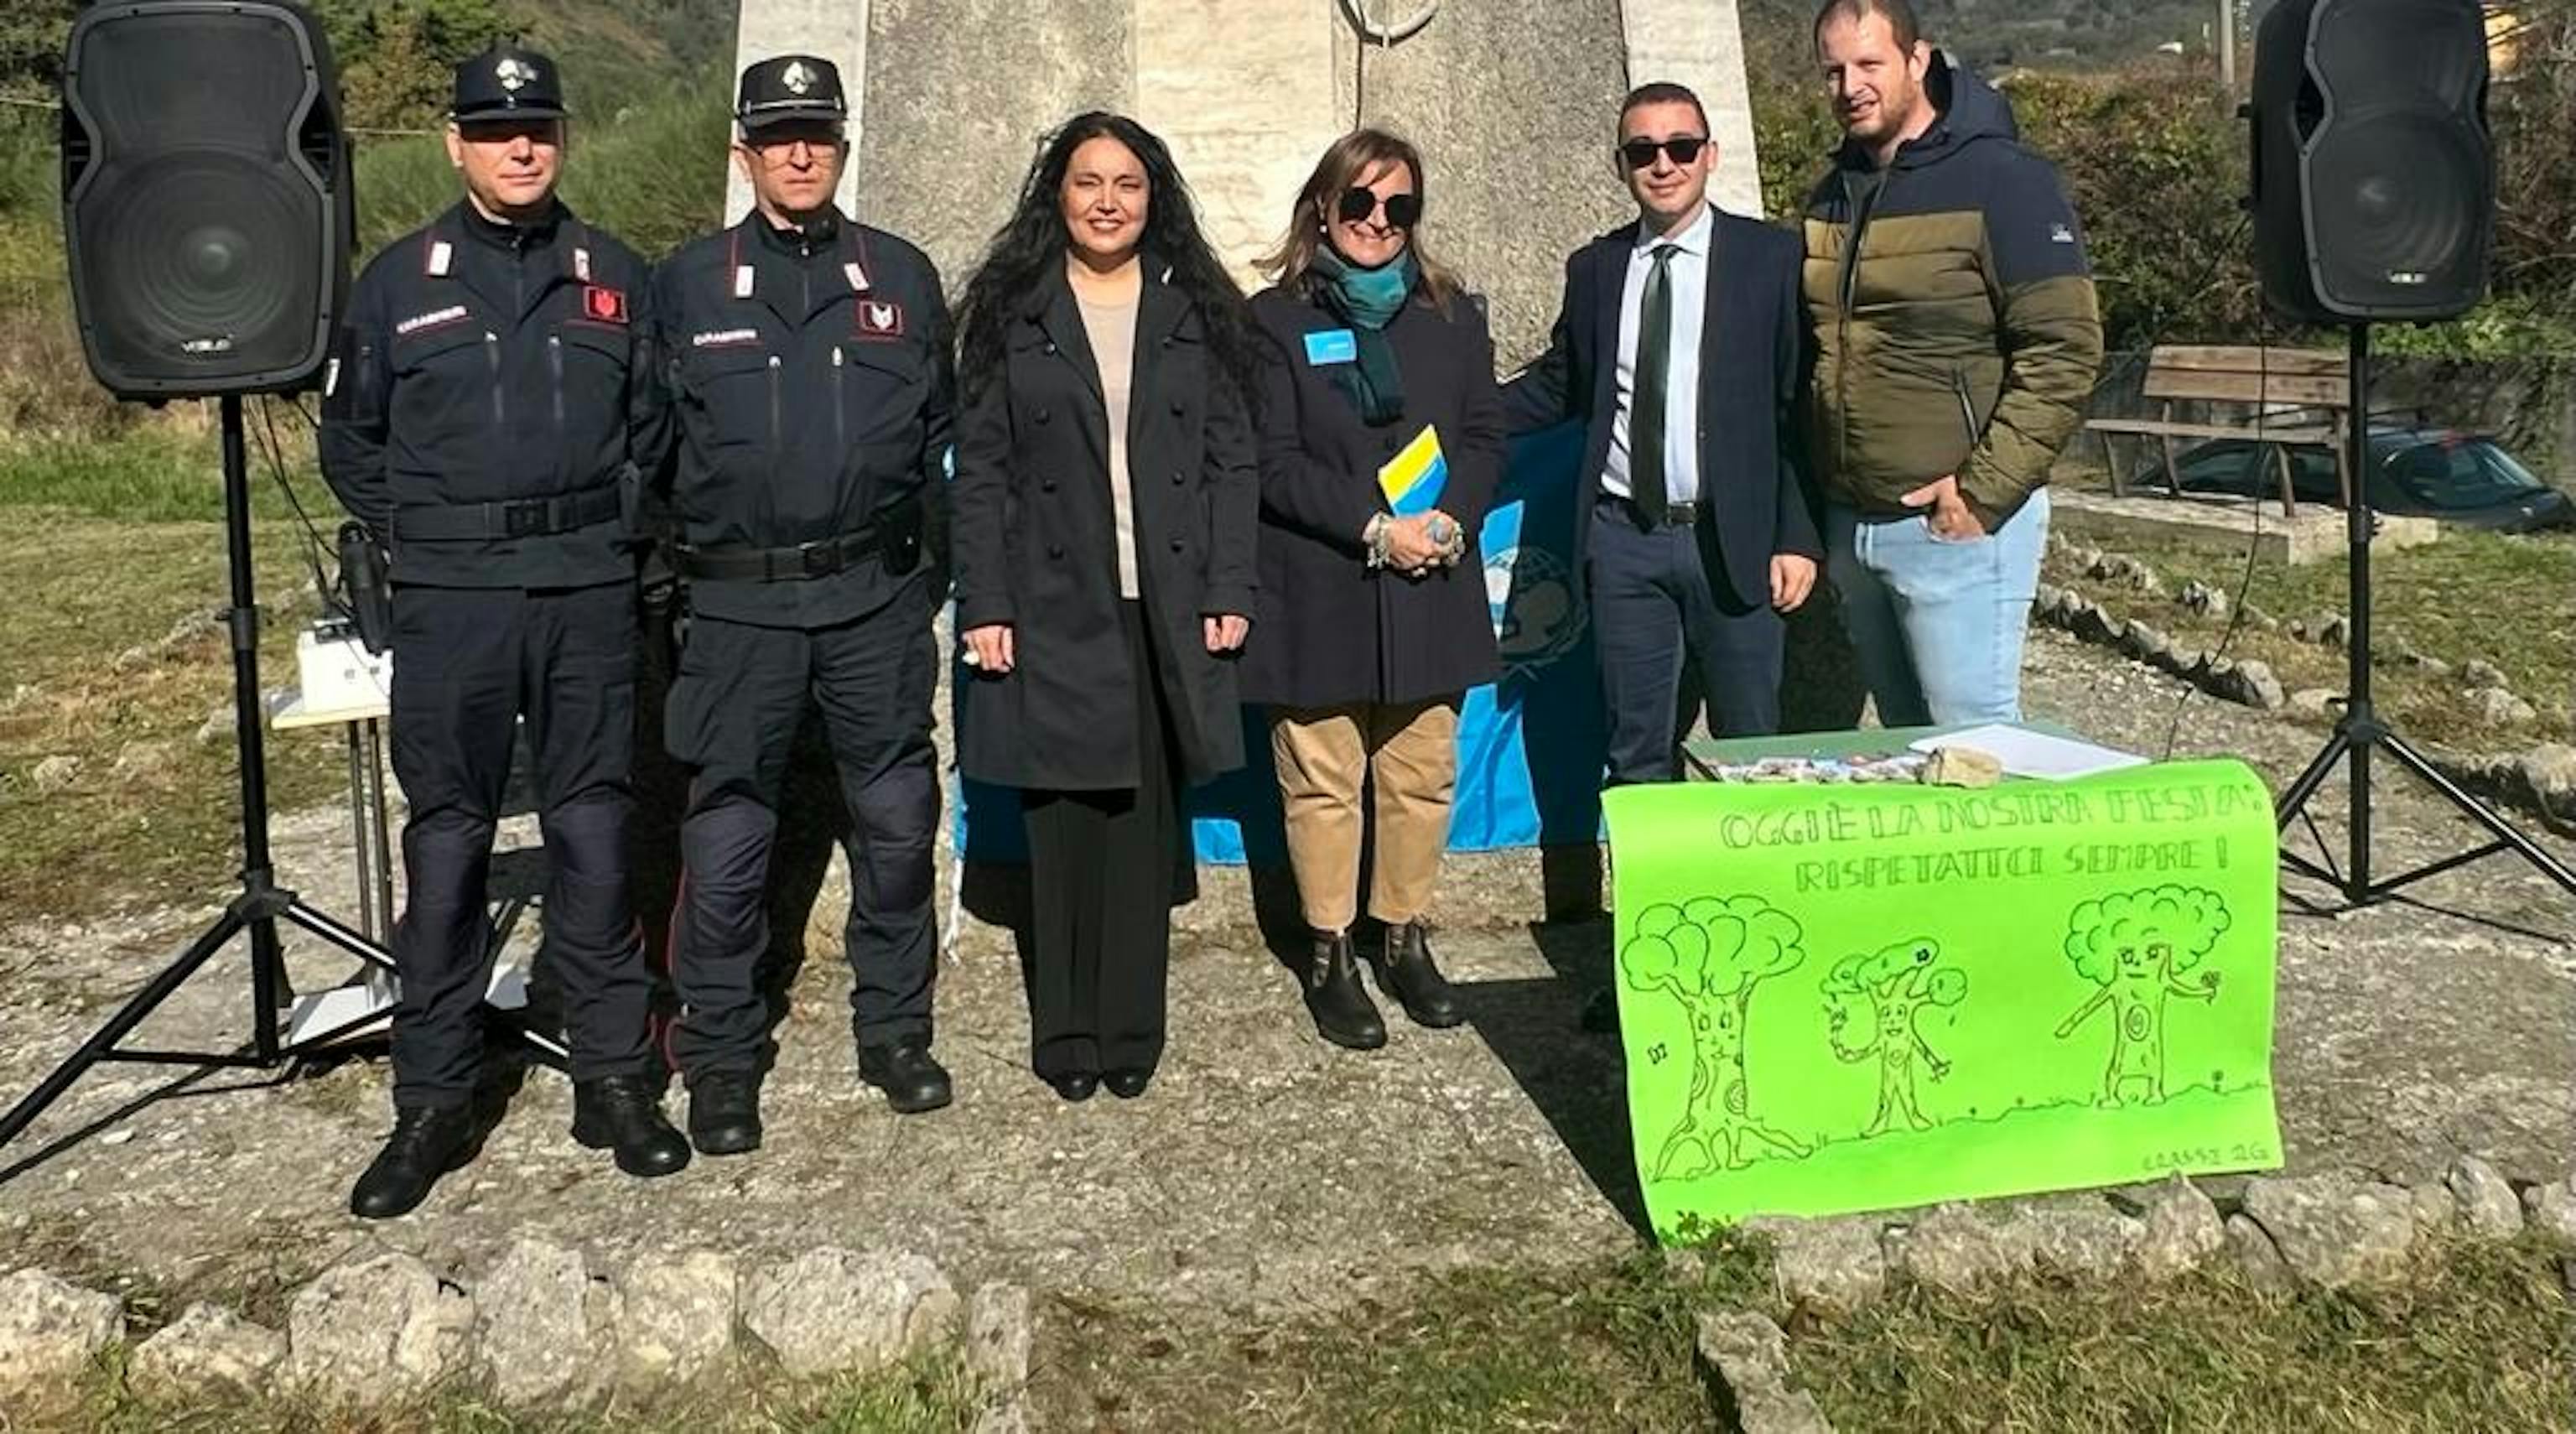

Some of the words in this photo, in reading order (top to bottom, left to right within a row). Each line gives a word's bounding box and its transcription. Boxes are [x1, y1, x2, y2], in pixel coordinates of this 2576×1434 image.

[1720, 809, 1820, 849] OGGI
[1867, 804, 1926, 839] LA
[1935, 790, 2094, 834] NOSTRA
[2063, 839, 2202, 875] SEMPRE
